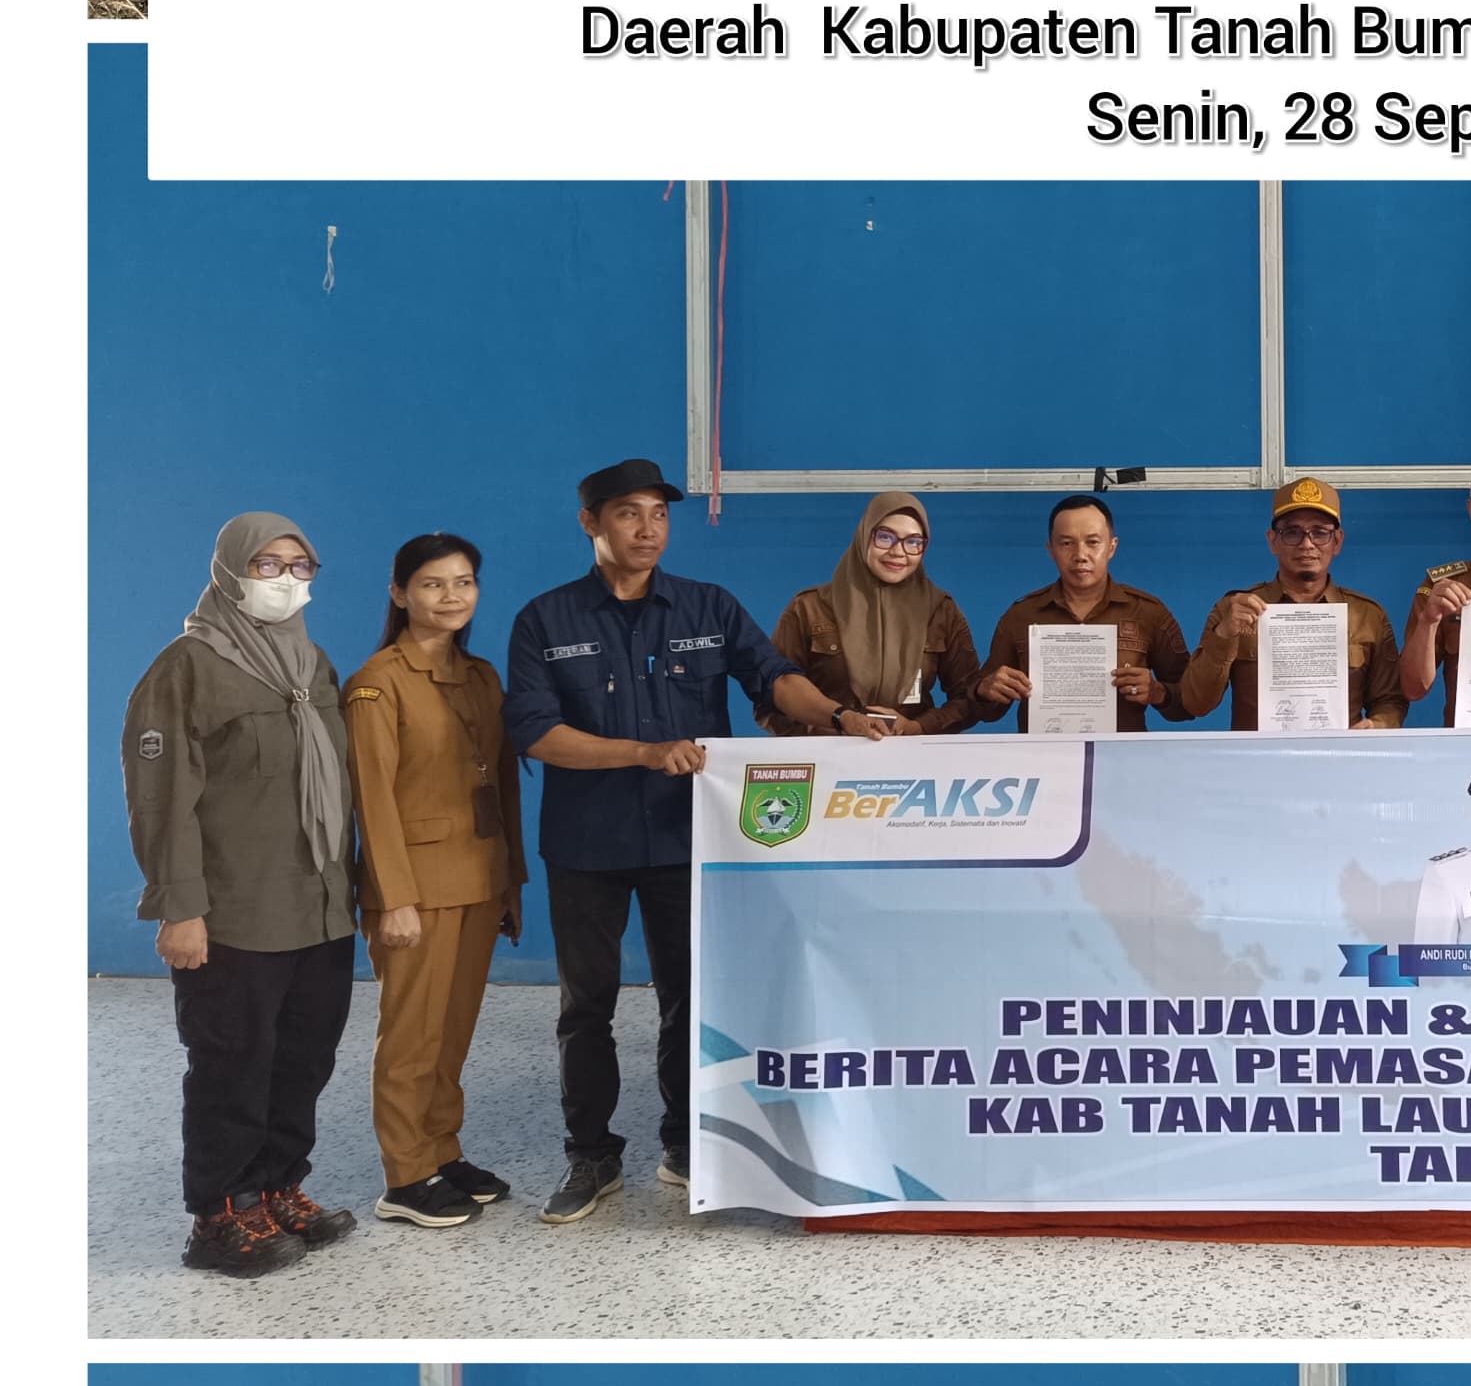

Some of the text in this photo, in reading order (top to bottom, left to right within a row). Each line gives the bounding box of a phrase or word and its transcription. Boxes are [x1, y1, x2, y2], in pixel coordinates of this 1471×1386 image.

[678, 637, 715, 650] ADWIL
[752, 769, 808, 780] TANAH BUMBU
[881, 783, 909, 791] Bumbu
[886, 820, 927, 829] Akomodatif,
[928, 820, 948, 829] Kerja,
[986, 819, 1000, 827] dan
[1001, 819, 1027, 828] Inovatif
[1420, 949, 1443, 961] ANDI
[1444, 949, 1467, 961] RUDI
[1001, 999, 1408, 1036] PENINJAUAN
[755, 1047, 975, 1090] BERITA
[990, 1048, 1219, 1085] ACARA
[968, 1097, 1104, 1135] KAB
[1121, 1096, 1340, 1133] TANAH
